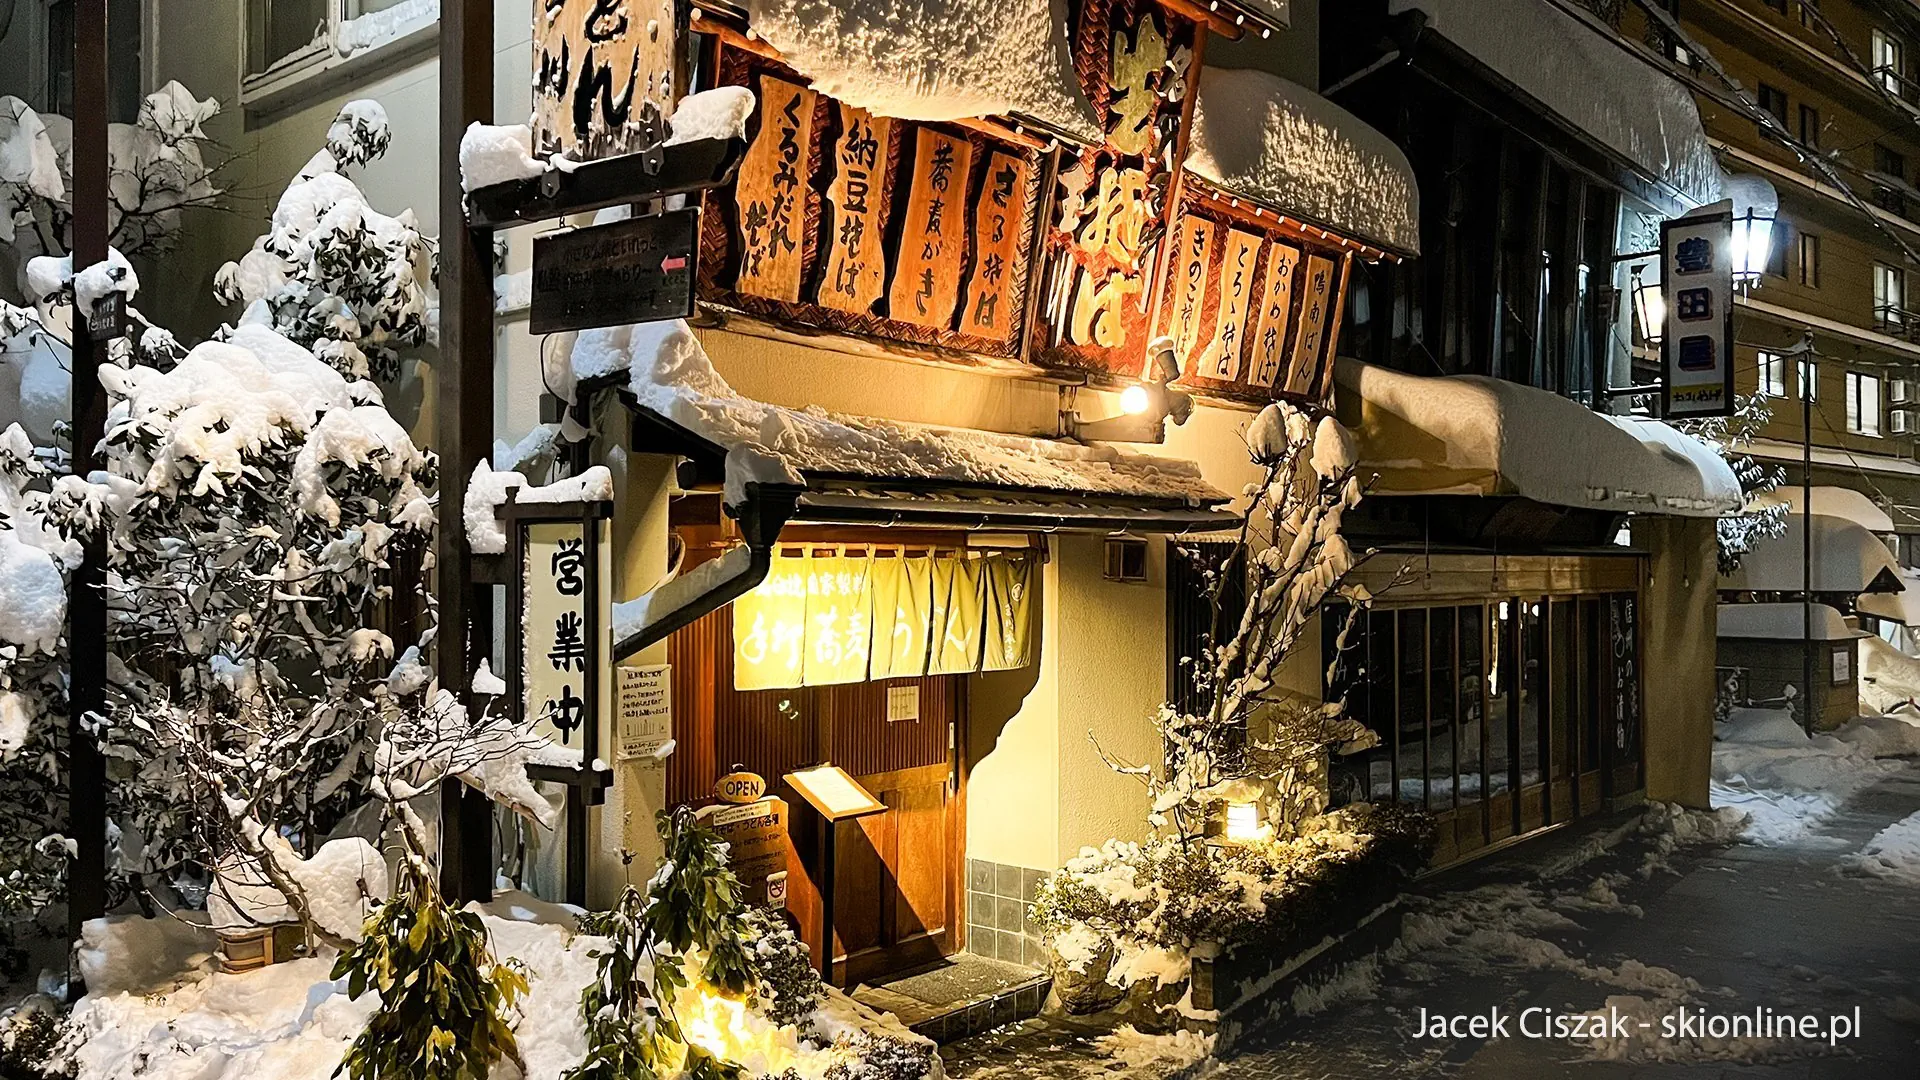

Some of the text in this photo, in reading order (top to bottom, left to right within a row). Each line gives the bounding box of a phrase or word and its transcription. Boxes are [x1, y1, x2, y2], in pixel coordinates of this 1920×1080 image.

[768, 92, 800, 260] くるみだれ
[915, 138, 954, 317] 蕎麦がき
[547, 537, 585, 745] 営業中
[725, 780, 759, 797] OPEN
